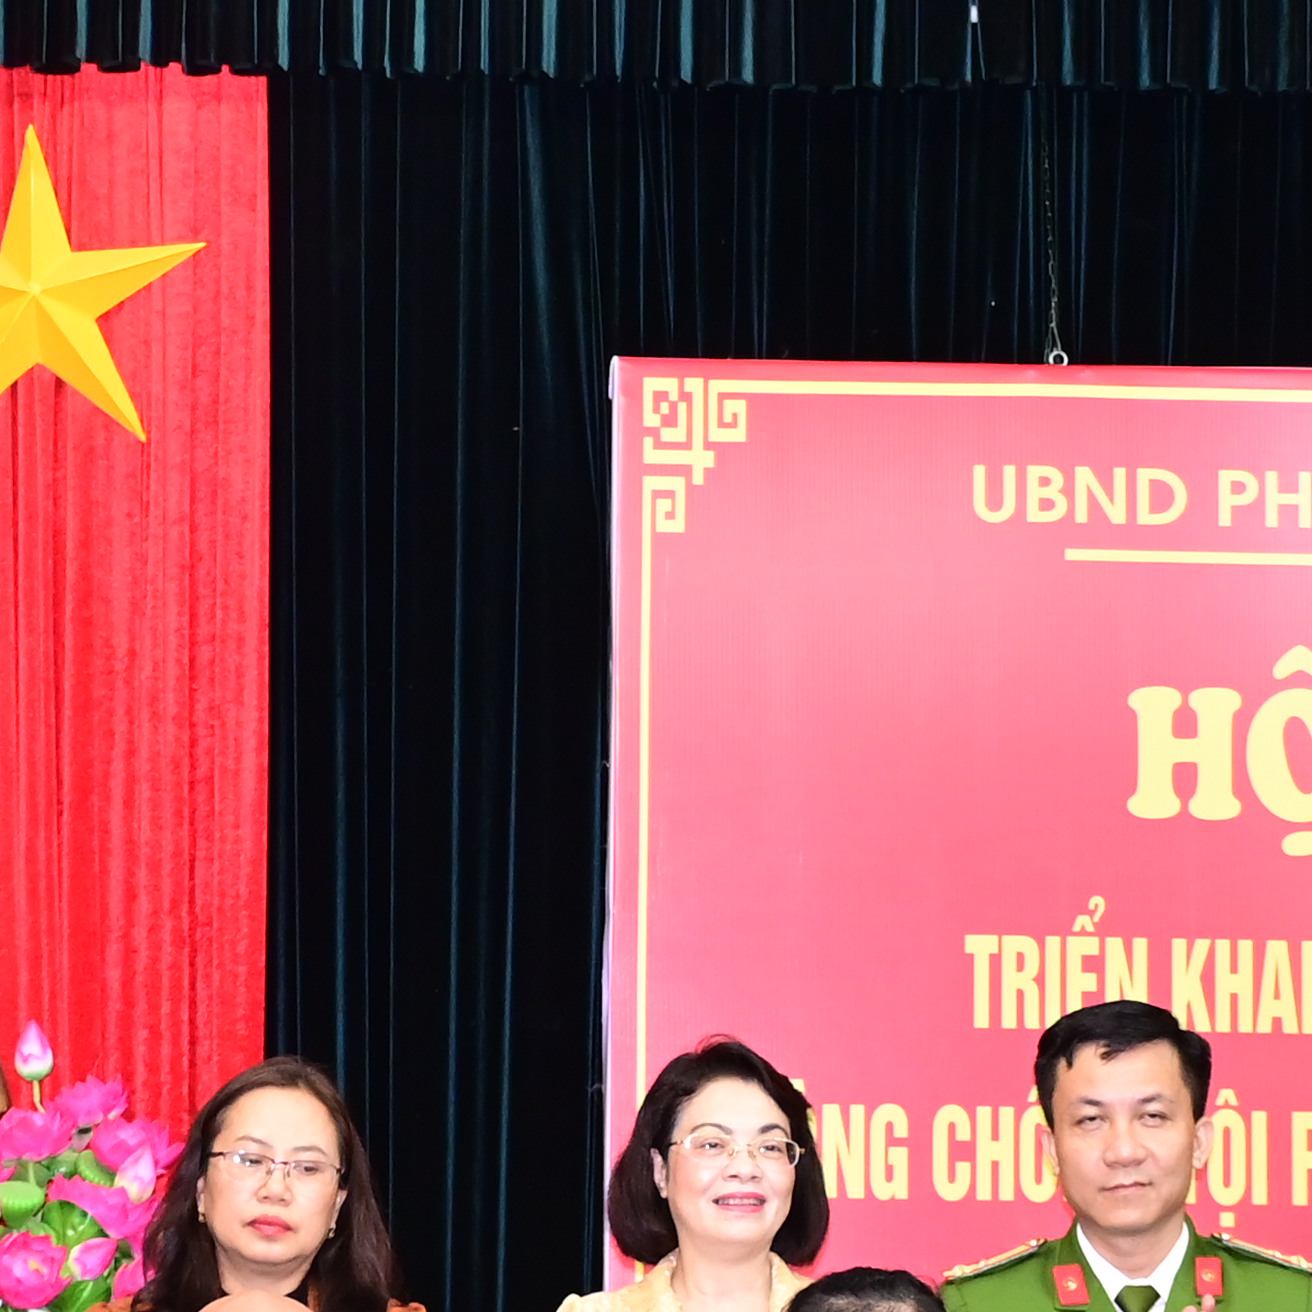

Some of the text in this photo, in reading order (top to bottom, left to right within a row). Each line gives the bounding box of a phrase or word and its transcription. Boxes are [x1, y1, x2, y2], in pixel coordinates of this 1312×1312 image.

[971, 464, 1189, 526] UBND
[964, 895, 1149, 1030] TRIỂN
[1185, 1087, 1269, 1229] ỘI
